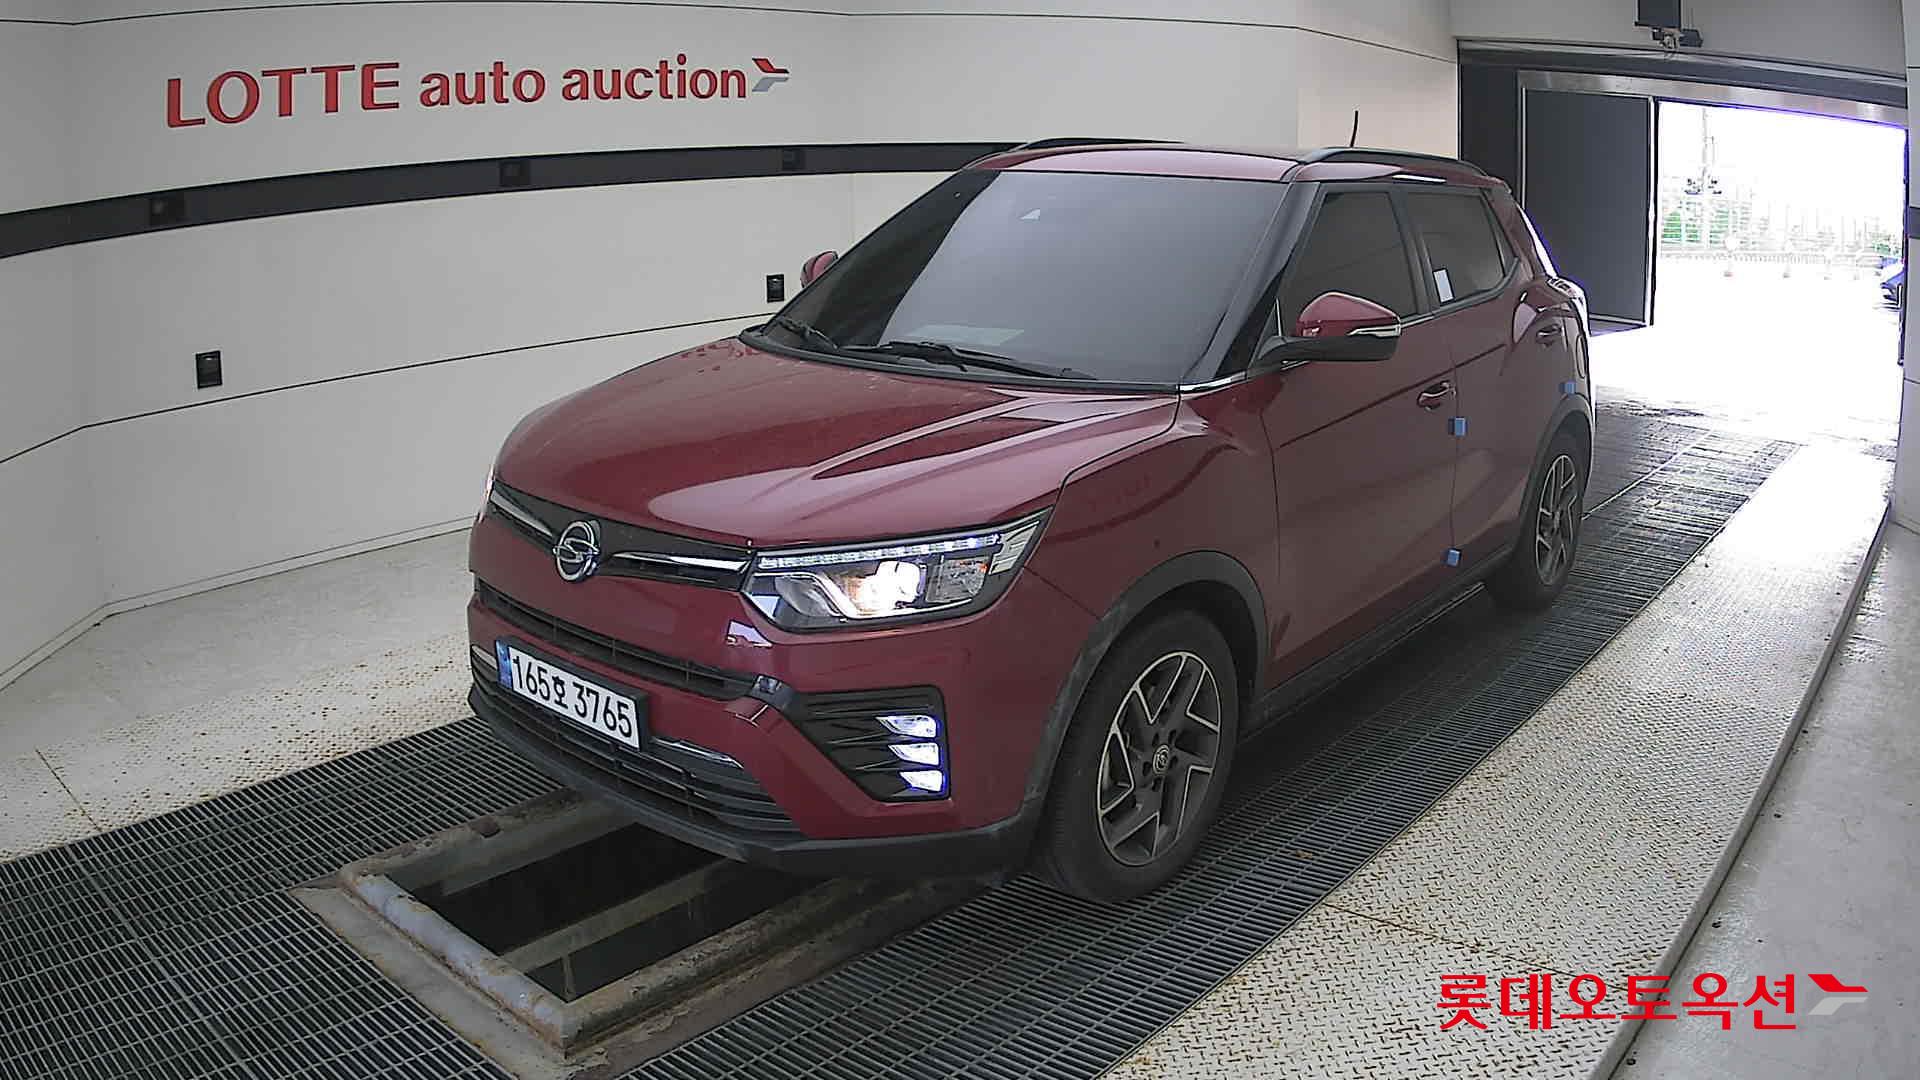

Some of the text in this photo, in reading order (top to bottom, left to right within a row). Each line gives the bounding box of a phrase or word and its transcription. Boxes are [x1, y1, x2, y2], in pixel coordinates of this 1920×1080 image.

[167, 53, 747, 128] LOTTE auto auction
[512, 655, 632, 738] 165호 3765
